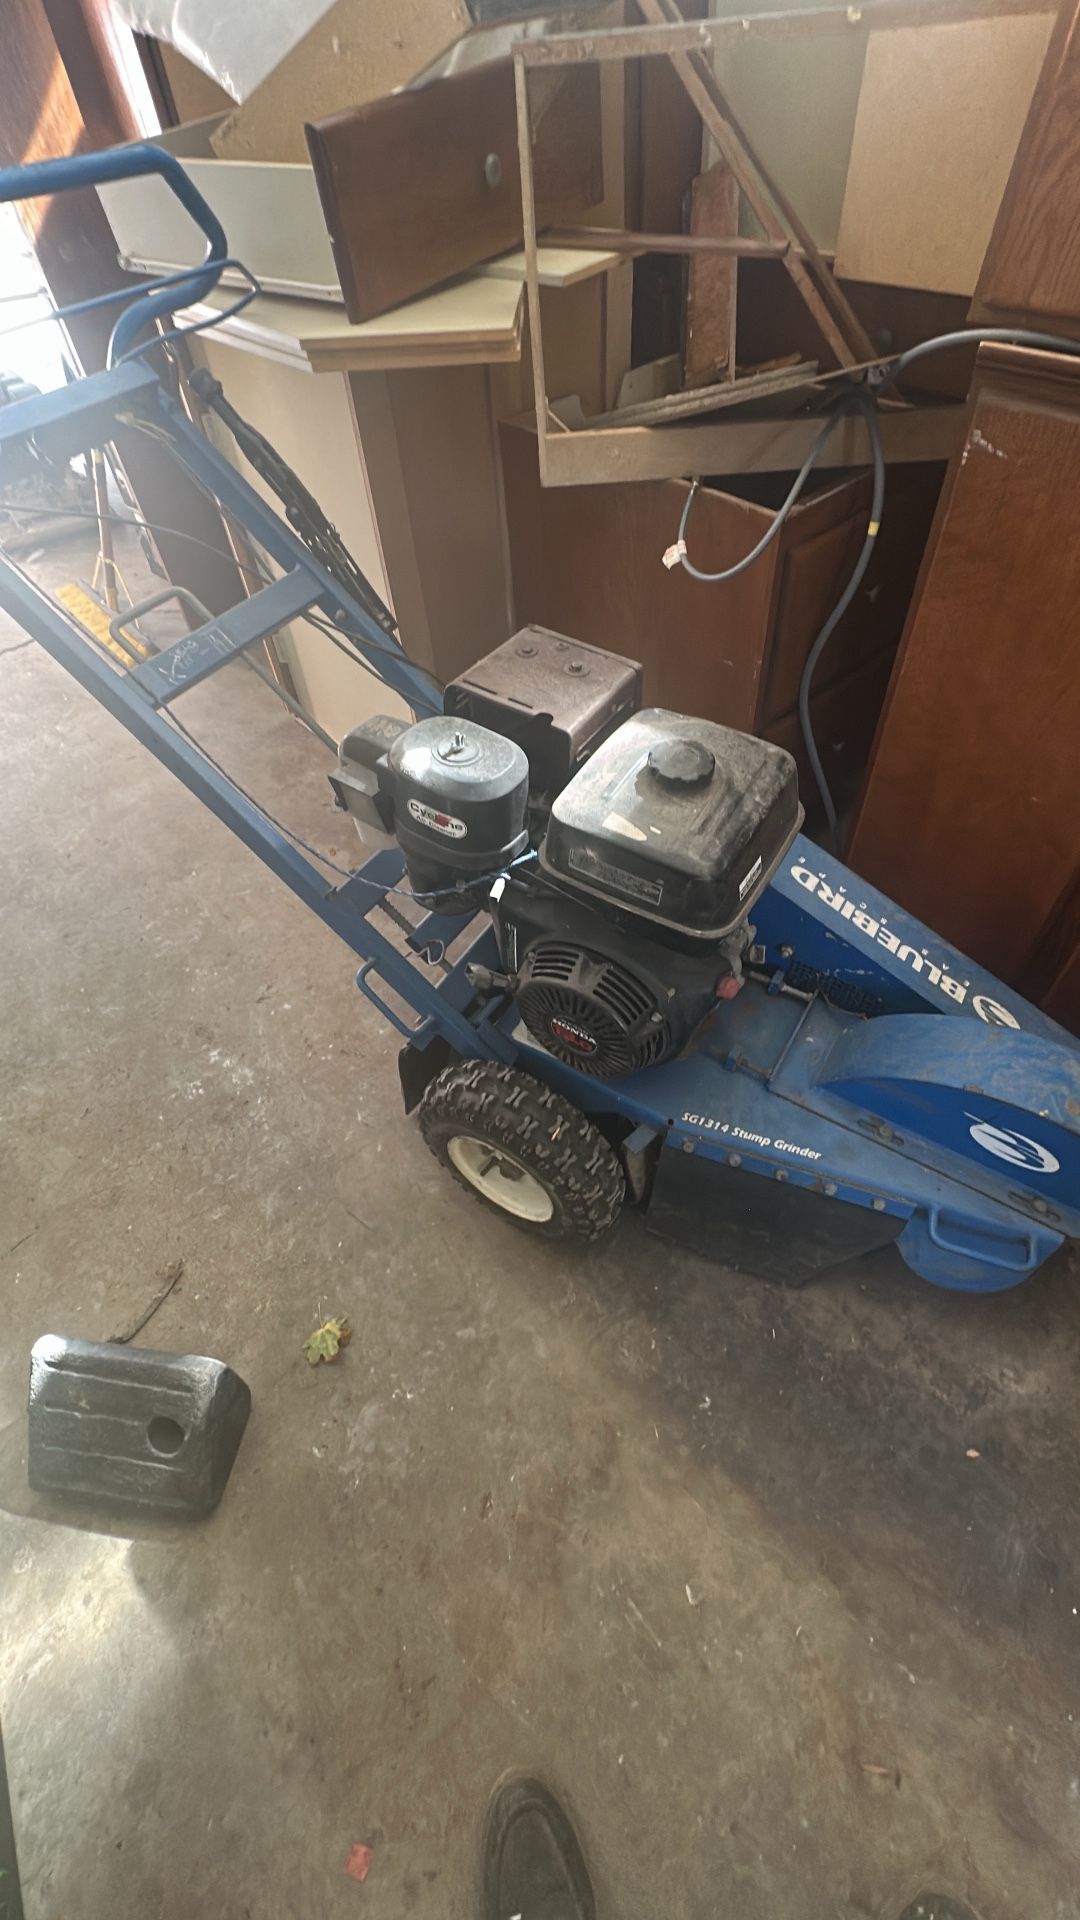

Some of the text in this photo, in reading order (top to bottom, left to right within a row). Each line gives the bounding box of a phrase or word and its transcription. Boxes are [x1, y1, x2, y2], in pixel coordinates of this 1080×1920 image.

[790, 865, 968, 1005] BLUEBIRD
[552, 1018, 597, 1045] HONDA
[682, 1112, 822, 1160] SG1314 Stump Grinder
